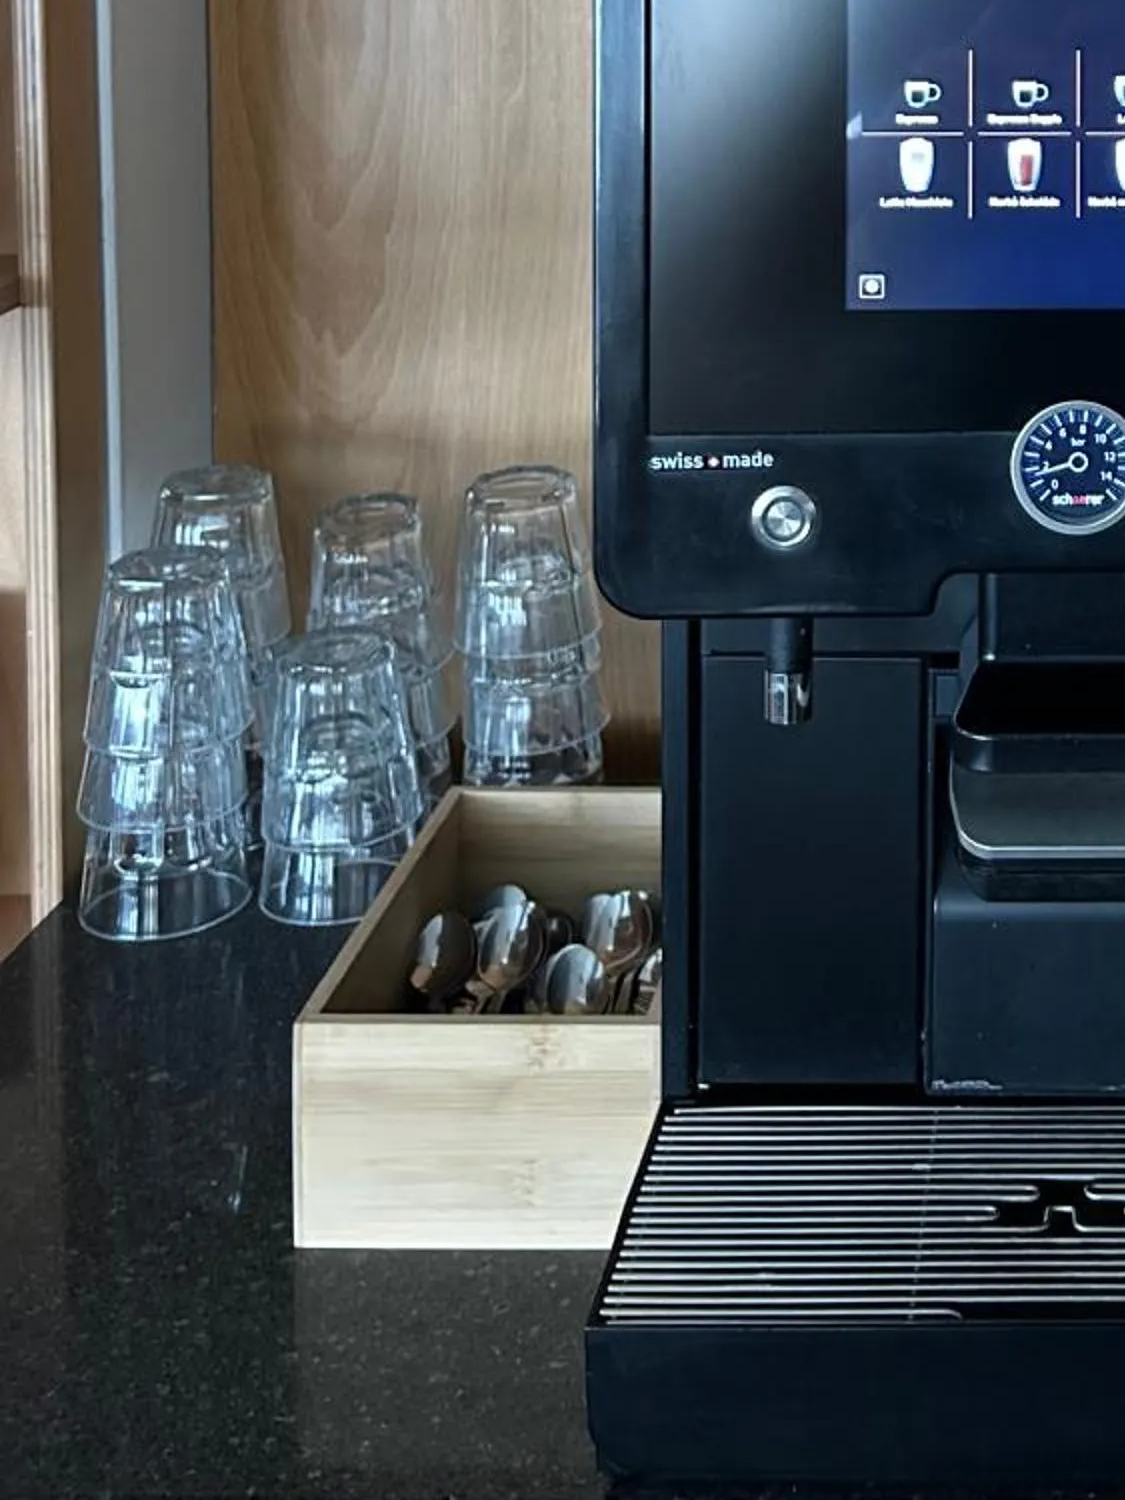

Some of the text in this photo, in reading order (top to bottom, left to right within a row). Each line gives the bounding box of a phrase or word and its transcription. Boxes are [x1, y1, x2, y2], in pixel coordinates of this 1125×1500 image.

[1095, 433, 1107, 444] 10
[649, 450, 774, 470] swiss made
[1100, 471, 1113, 481] 14
[1051, 479, 1059, 490] 0
